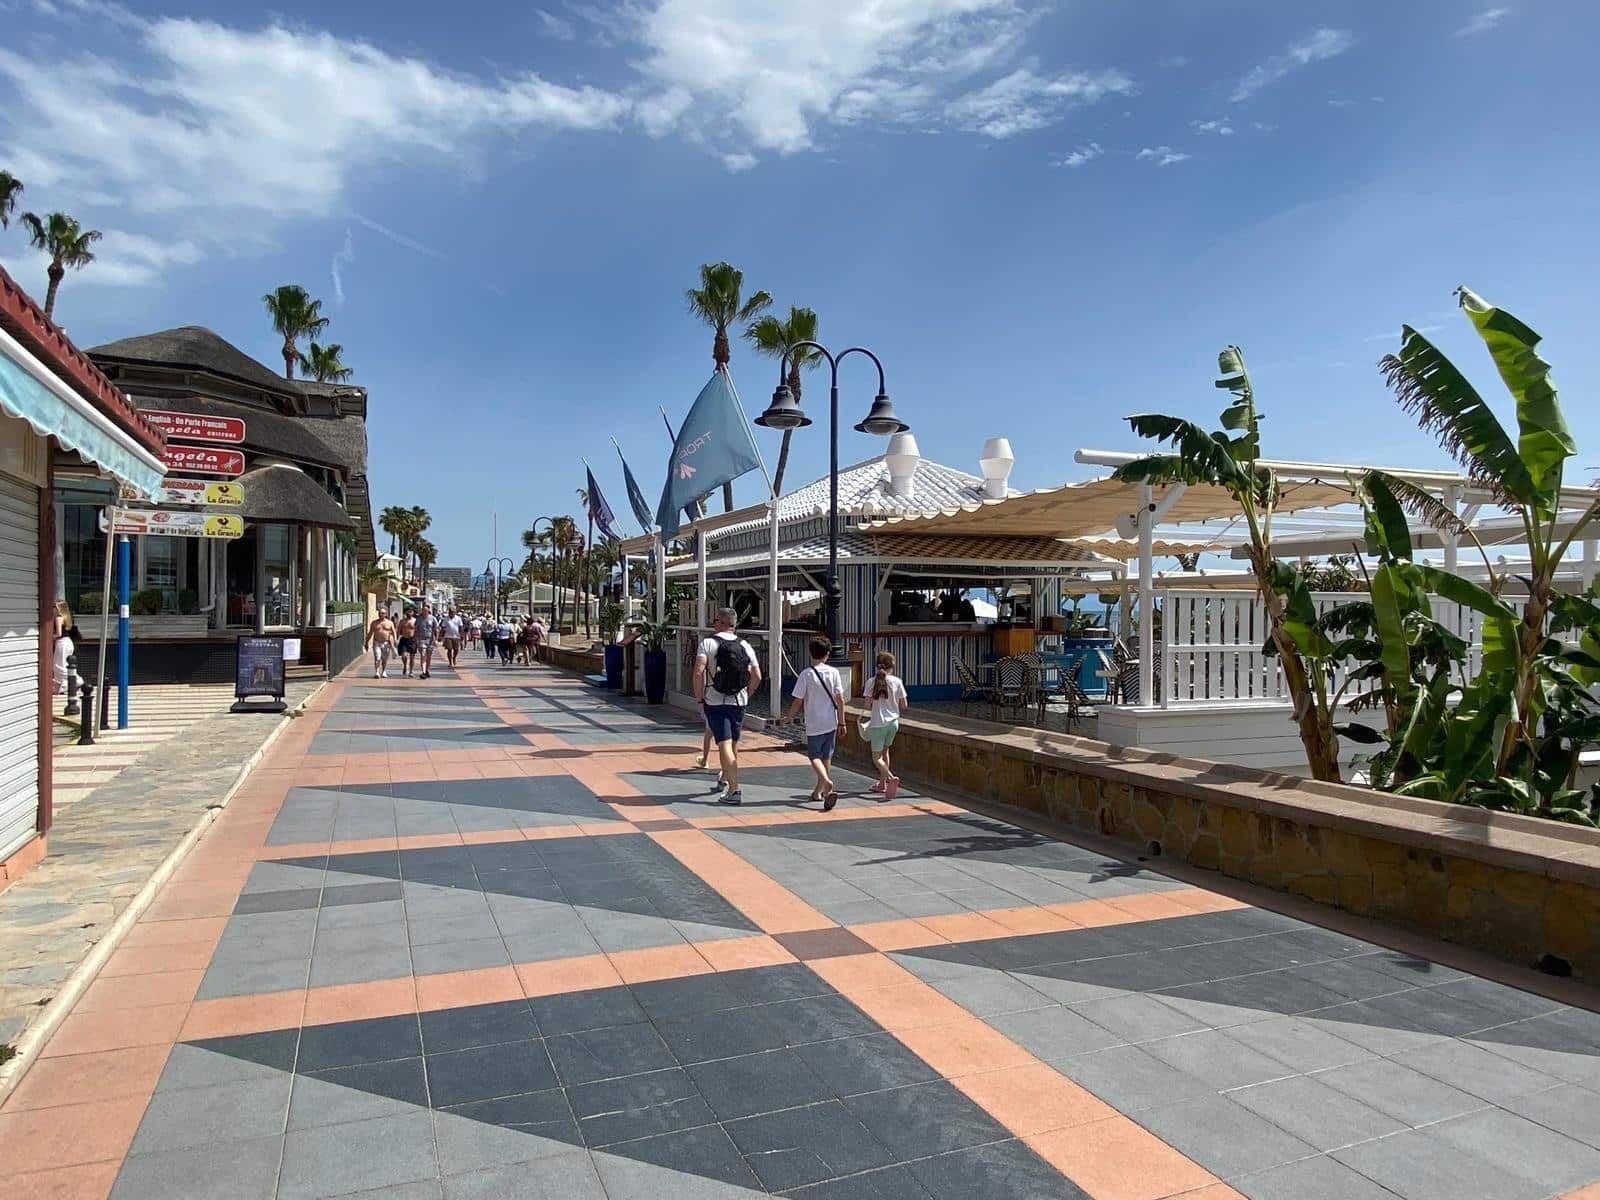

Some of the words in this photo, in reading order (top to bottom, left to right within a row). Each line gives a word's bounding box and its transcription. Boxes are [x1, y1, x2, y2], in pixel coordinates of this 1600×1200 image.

[165, 452, 217, 462] ngela
[207, 495, 216, 503] La
[218, 496, 241, 504] Granja
[218, 529, 241, 537] Granja
